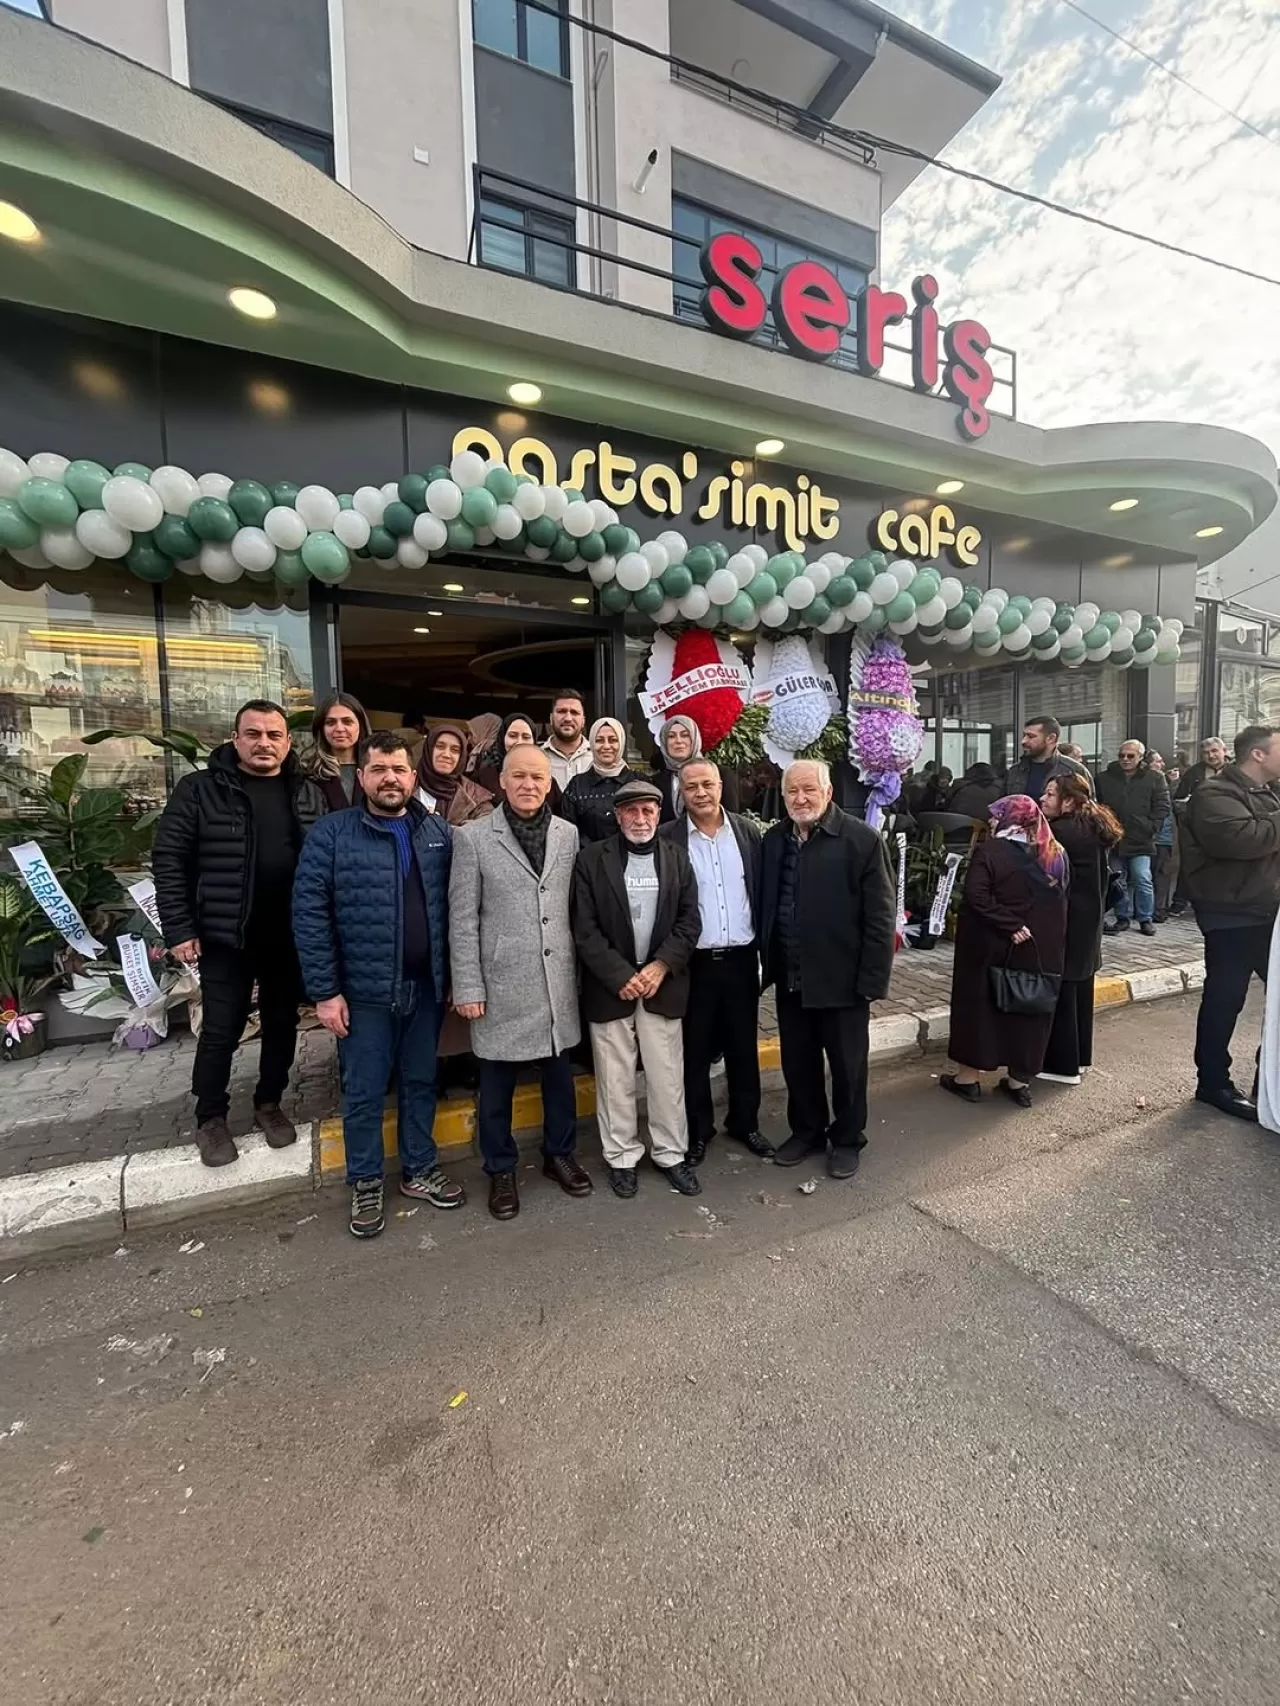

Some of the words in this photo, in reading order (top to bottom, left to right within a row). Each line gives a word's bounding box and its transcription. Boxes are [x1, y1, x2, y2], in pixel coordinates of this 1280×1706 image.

[700, 231, 994, 441] seriş
[877, 504, 982, 566] cafe
[649, 700, 666, 714] UN
[682, 680, 709, 695] YEM
[775, 676, 818, 697] GÜLER
[23, 869, 54, 909] AHMET
[50, 910, 71, 938] USTA
[121, 943, 134, 968] BUKET
